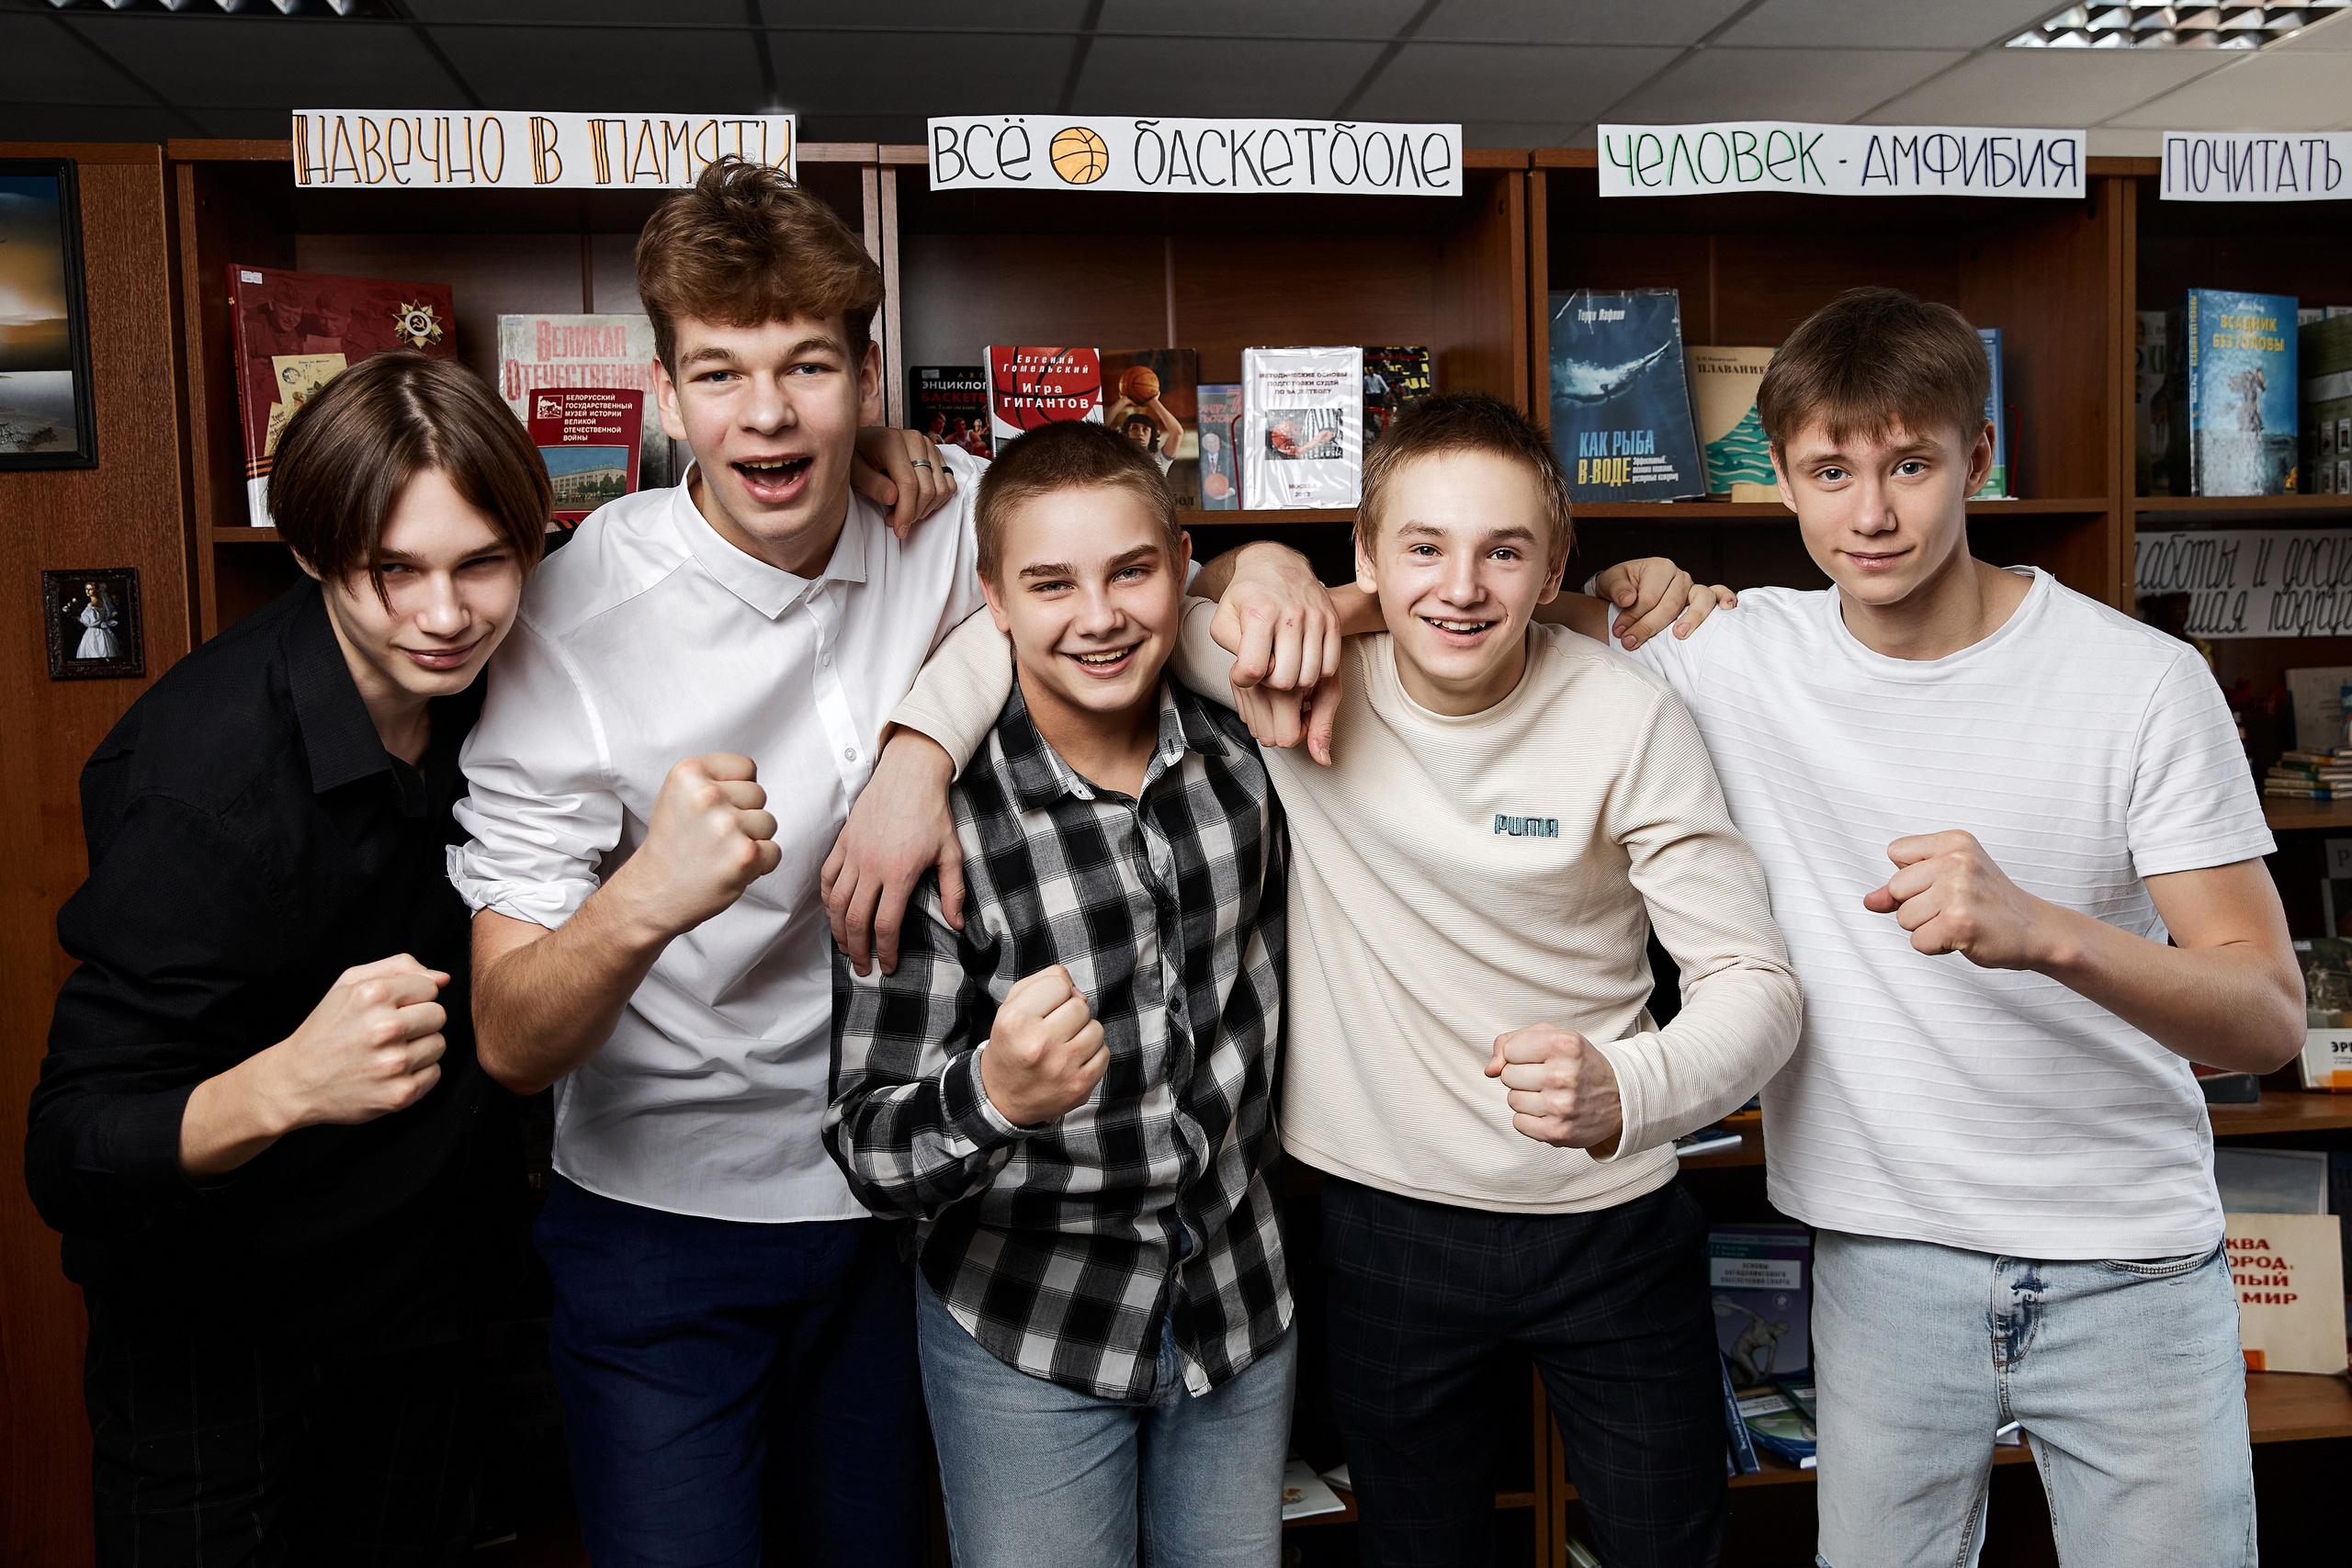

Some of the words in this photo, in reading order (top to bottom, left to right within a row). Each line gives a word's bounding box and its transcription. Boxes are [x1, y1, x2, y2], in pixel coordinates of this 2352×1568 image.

[529, 117, 562, 185] В
[1861, 133, 2078, 187] АМФИБИЯ
[2165, 138, 2342, 193] ПОЧИТАТЬ
[2221, 314, 2278, 332] ВСАДНИК
[536, 320, 628, 362] ВЕЛИКАЯ
[2213, 333, 2233, 348] БЕЗ
[2236, 334, 2285, 352] ГОЛОВЫ
[1017, 354, 1074, 365] Евгений
[1002, 363, 1090, 375] Гомельский
[1023, 382, 1063, 395] Игра
[565, 401, 633, 410] ГОСУДАРСТВЕННЫЙ
[1004, 397, 1090, 409] ГИГАНТОВ
[563, 433, 588, 441] ВОЙНЫ
[1578, 432, 1608, 457] КАК
[1612, 430, 1654, 457] РЫБА
[1577, 459, 1588, 484] В
[1592, 457, 1632, 487] ВОДЕ
[1494, 814, 1559, 838] PUMA
[2330, 1040, 2352, 1053] ЭР
[2242, 1292, 2297, 1304] МИР
